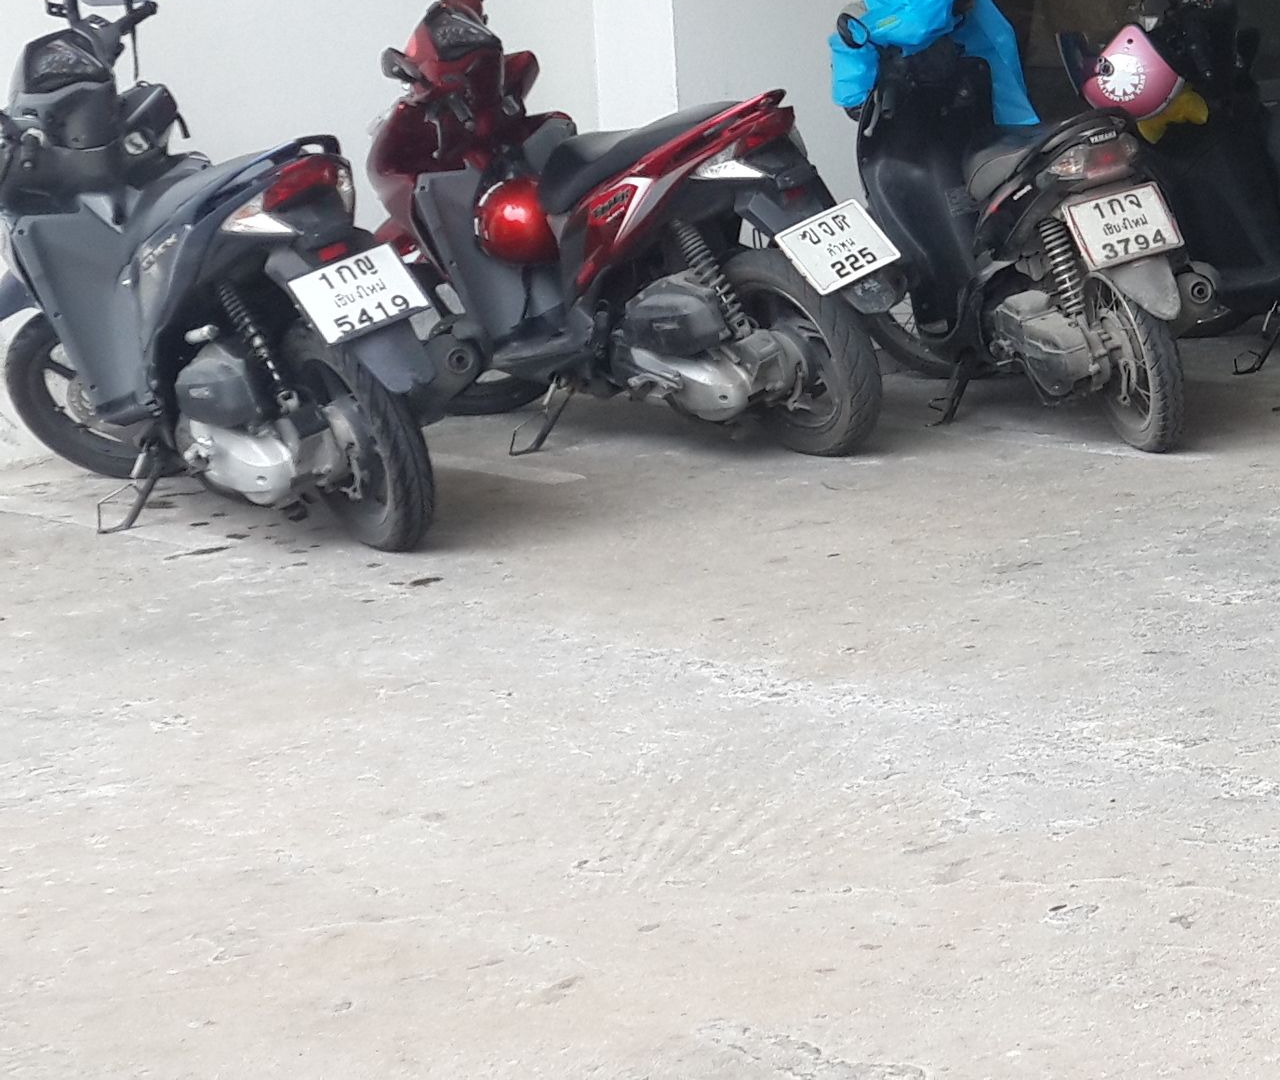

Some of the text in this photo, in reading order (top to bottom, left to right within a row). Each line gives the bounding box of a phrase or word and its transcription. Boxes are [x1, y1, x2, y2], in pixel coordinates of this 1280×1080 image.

[1093, 193, 1142, 219] 1กจ
[1103, 213, 1149, 237] เชียงใหม่
[1102, 228, 1167, 260] 3794
[319, 255, 379, 289] 1กญ
[831, 247, 878, 279] 225
[334, 278, 388, 308] เชียงใหม่
[334, 294, 410, 334] 5419
